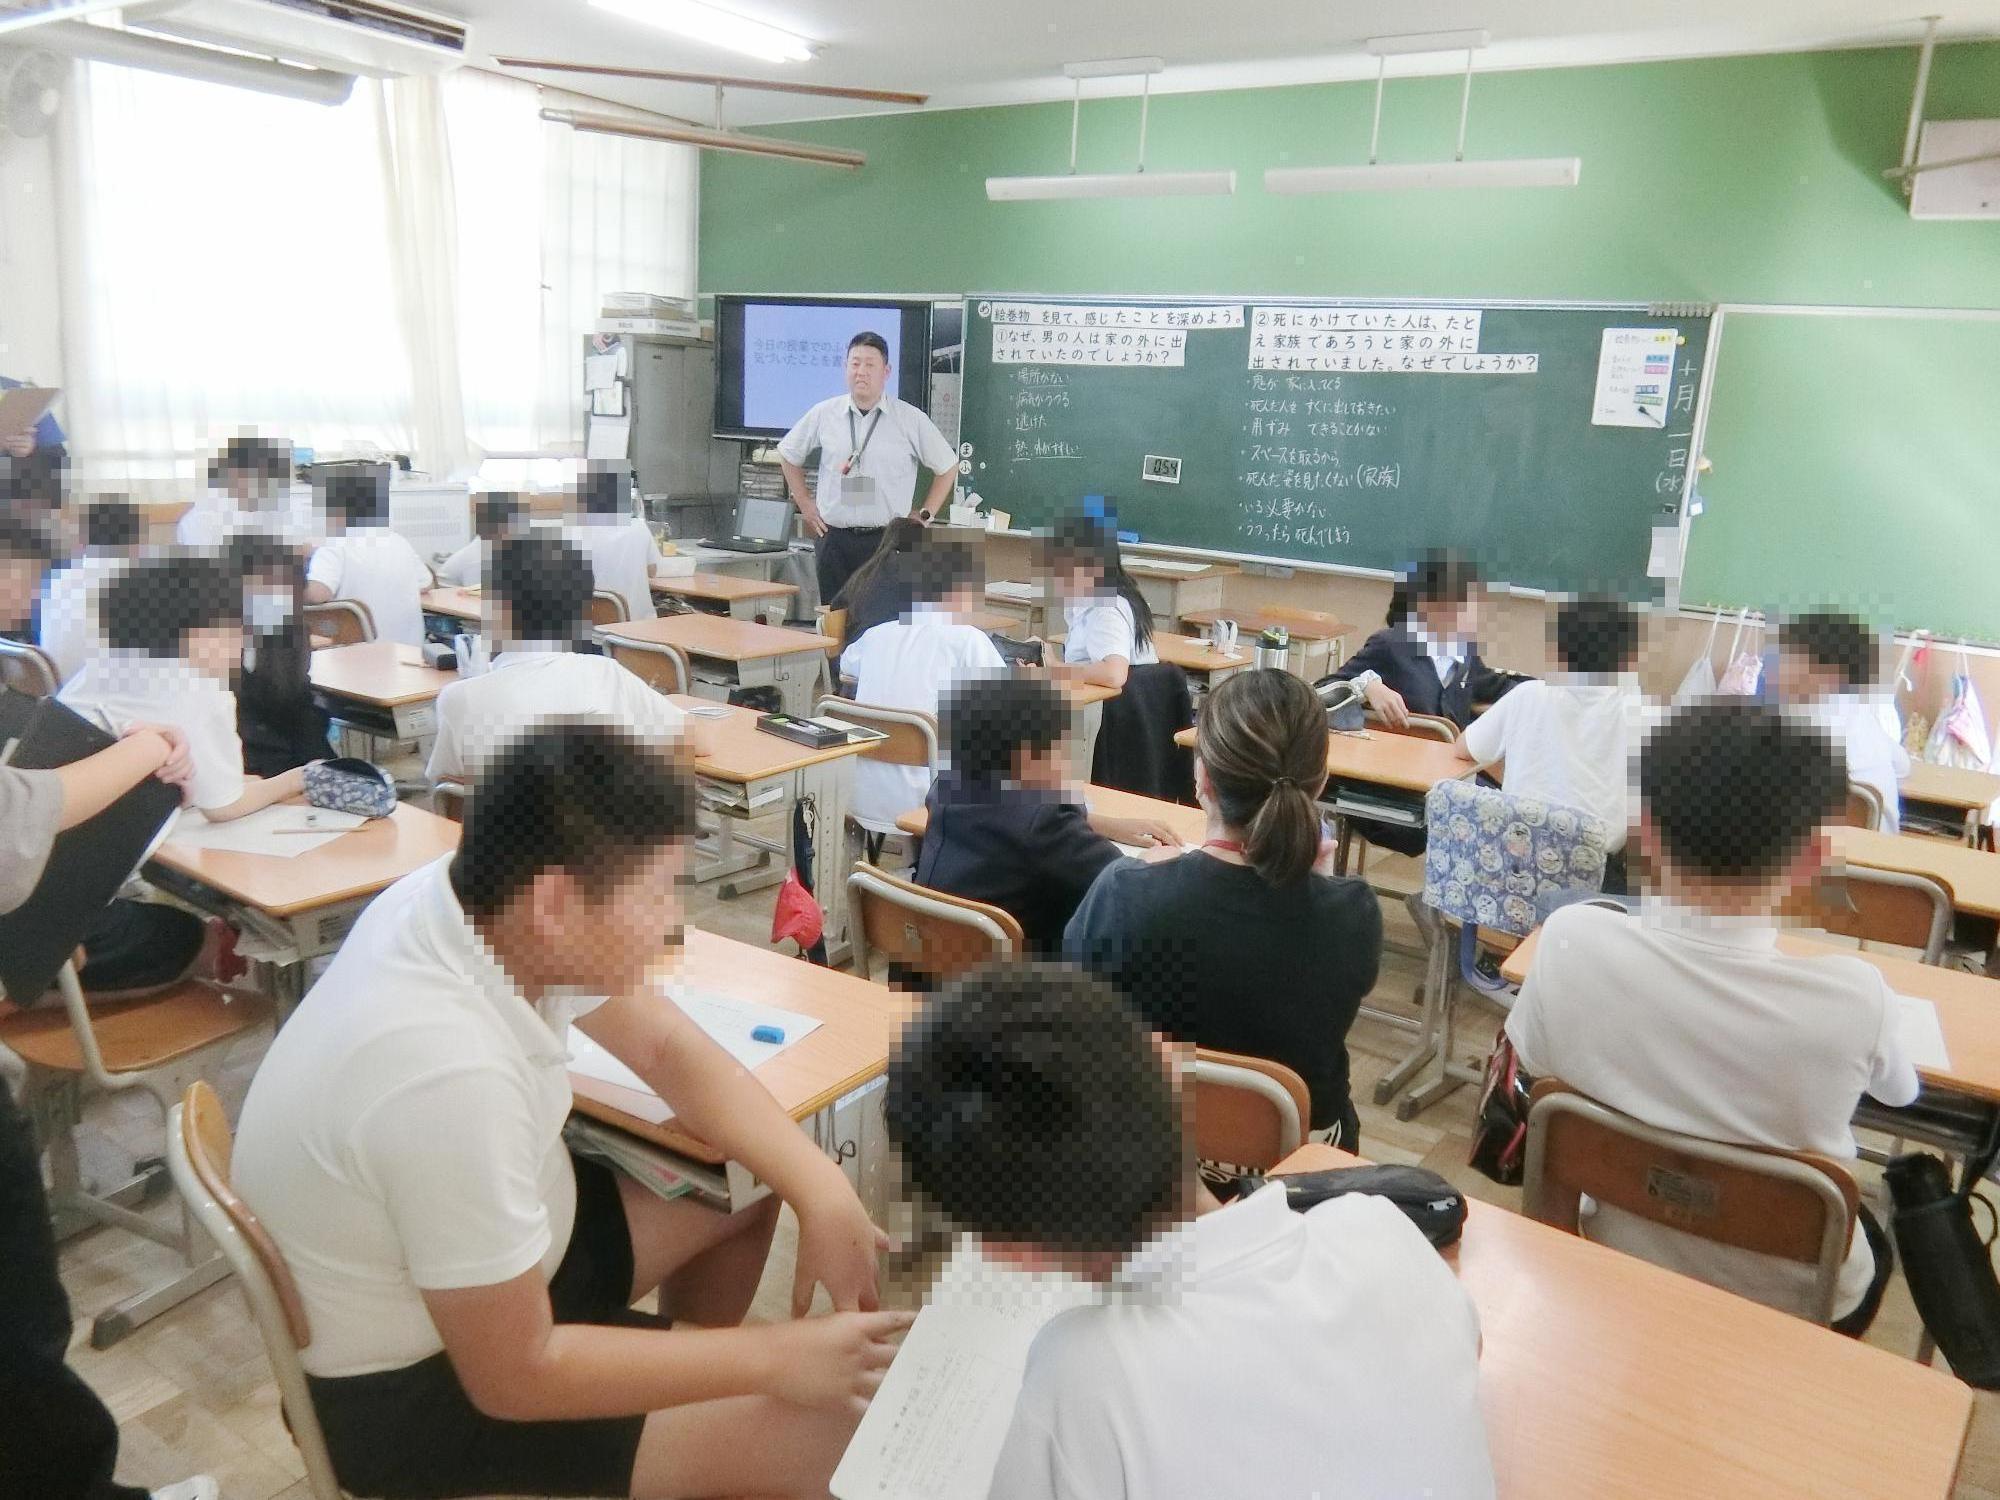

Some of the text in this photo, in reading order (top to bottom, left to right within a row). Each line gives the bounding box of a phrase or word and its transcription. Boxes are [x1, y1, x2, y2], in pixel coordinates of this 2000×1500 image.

[1255, 311, 1475, 330] ②死にかけていた人は、たと
[996, 329, 1183, 348] ①なぜ、男の人は家の外に出
[1255, 333, 1473, 350] え家族であろうと家の外に
[996, 347, 1169, 363] されていたのでしょうか？
[1252, 355, 1537, 373] 出されていました。なぜでしょうか？
